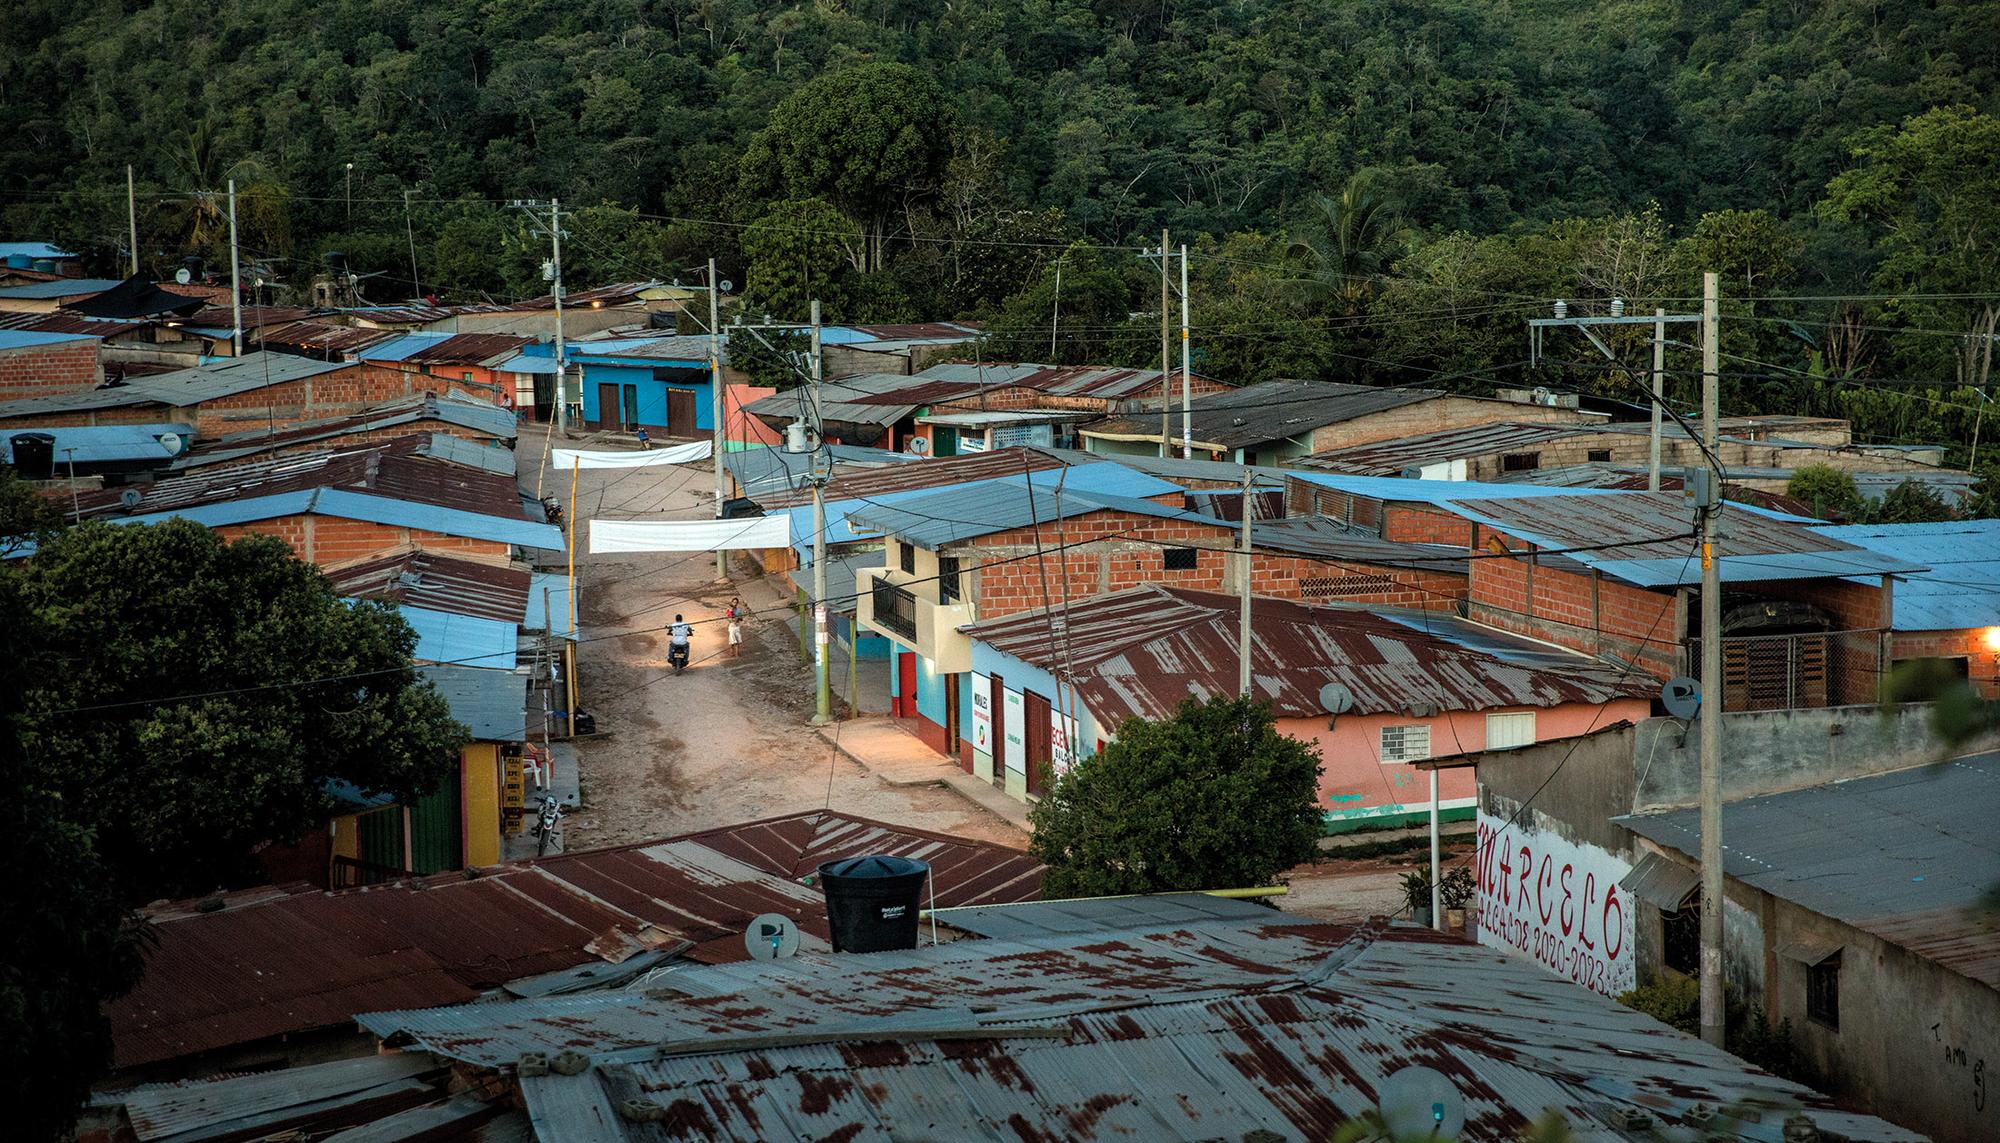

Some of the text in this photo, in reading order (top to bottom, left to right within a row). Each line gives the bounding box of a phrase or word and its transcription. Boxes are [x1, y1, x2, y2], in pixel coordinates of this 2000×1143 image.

[1477, 821, 1622, 961] MARCELO
[1477, 897, 1608, 996] ALCALDE 2020-2023
[1945, 1045, 1967, 1067] AMO
